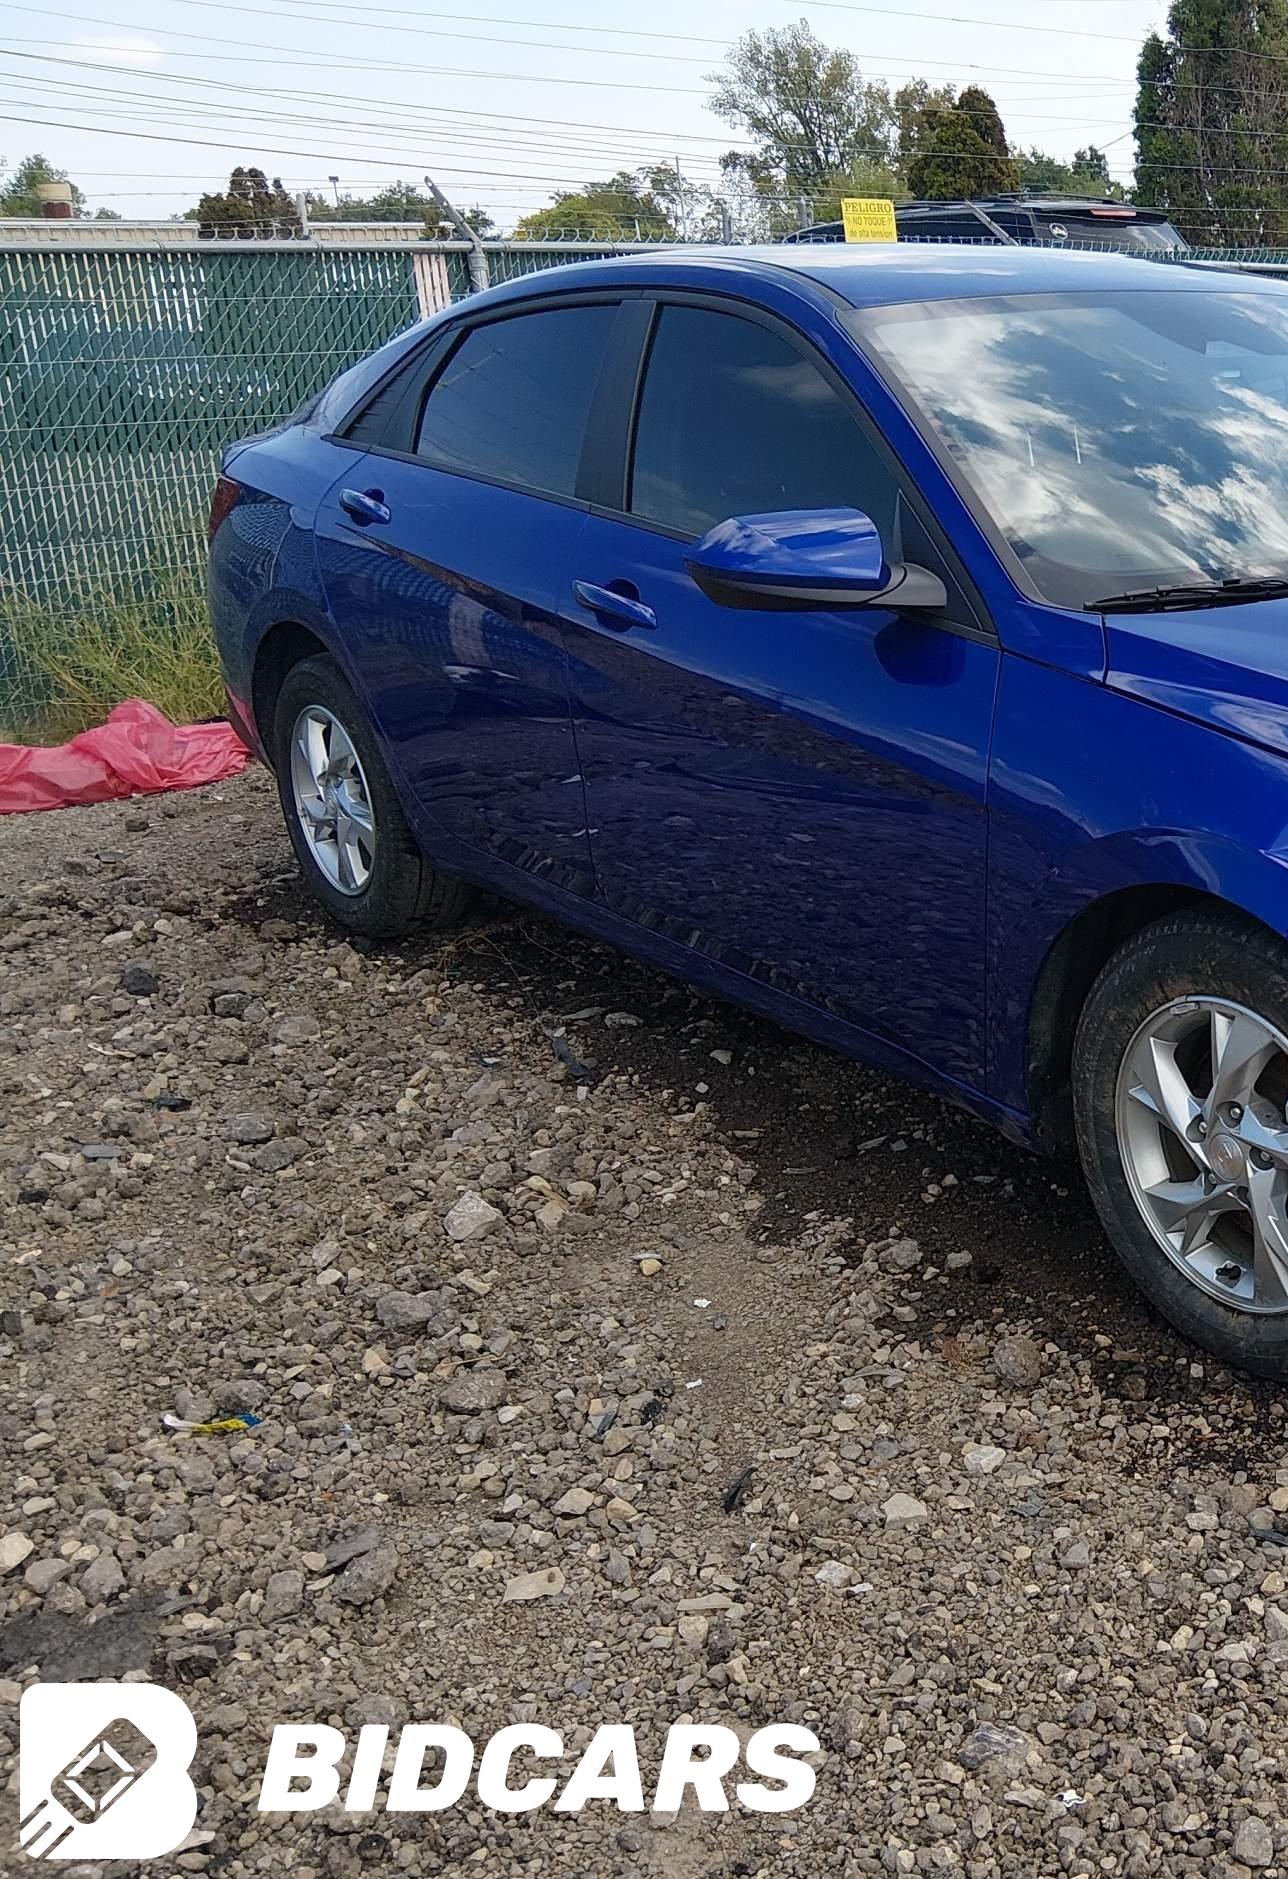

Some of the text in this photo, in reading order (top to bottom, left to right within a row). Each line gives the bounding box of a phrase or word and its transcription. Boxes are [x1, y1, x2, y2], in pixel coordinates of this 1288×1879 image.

[845, 202, 892, 213] PELIGRO
[852, 216, 887, 226] NO TOQUE
